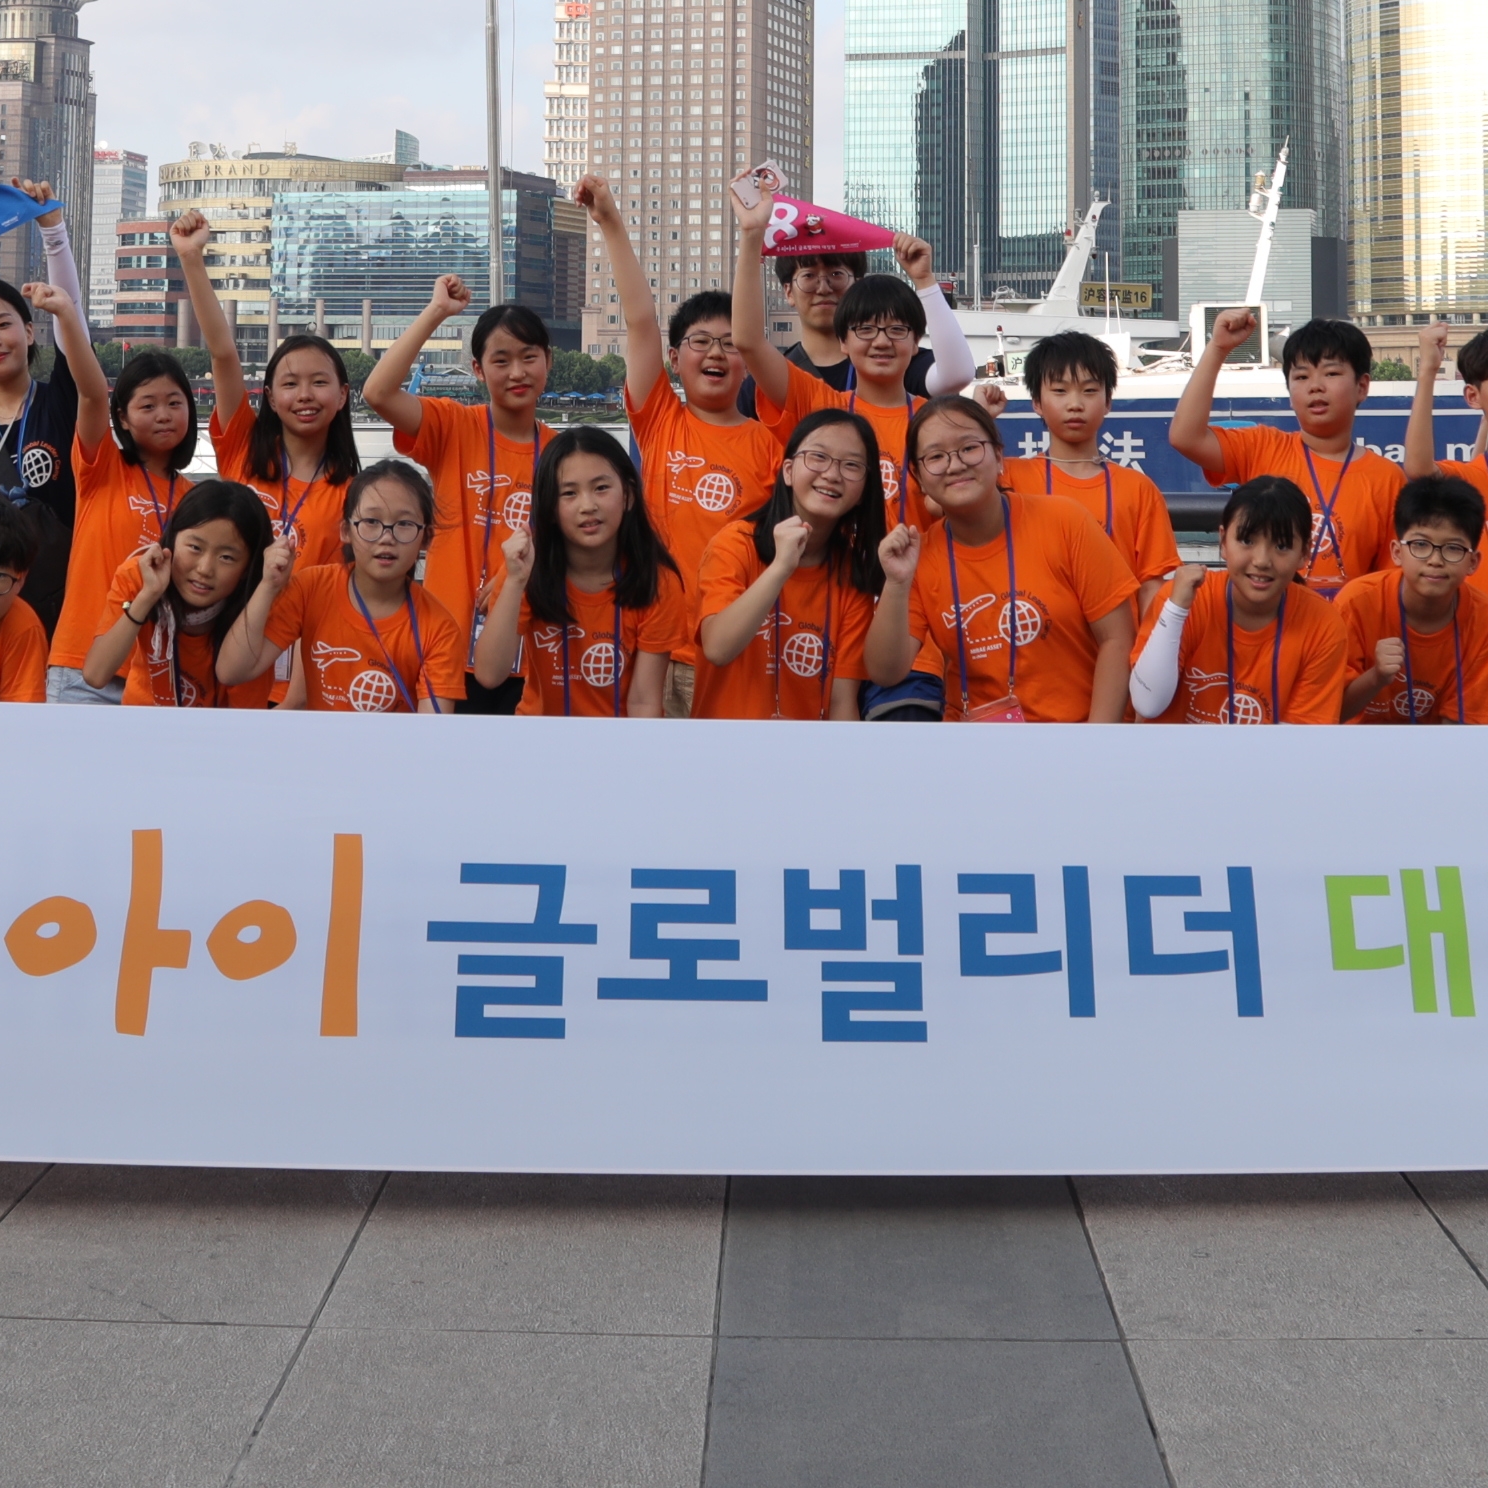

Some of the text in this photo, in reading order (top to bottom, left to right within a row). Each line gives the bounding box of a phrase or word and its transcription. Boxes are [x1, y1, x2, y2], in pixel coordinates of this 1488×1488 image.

[204, 163, 270, 177] BRAND
[289, 163, 347, 178] MALL
[1084, 287, 1148, 304] 沪容环监16
[515, 481, 533, 490] Glob
[709, 463, 732, 475] Global
[731, 470, 744, 498] Leader
[1000, 589, 1025, 602] Glbal
[1027, 591, 1050, 618] Leader
[798, 621, 824, 633] Global
[970, 643, 1002, 655] MIRAE ASSET
[367, 658, 394, 673] Globa
[1234, 681, 1272, 722] Global Leader
[427, 863, 1263, 1041] 글로벌리더
